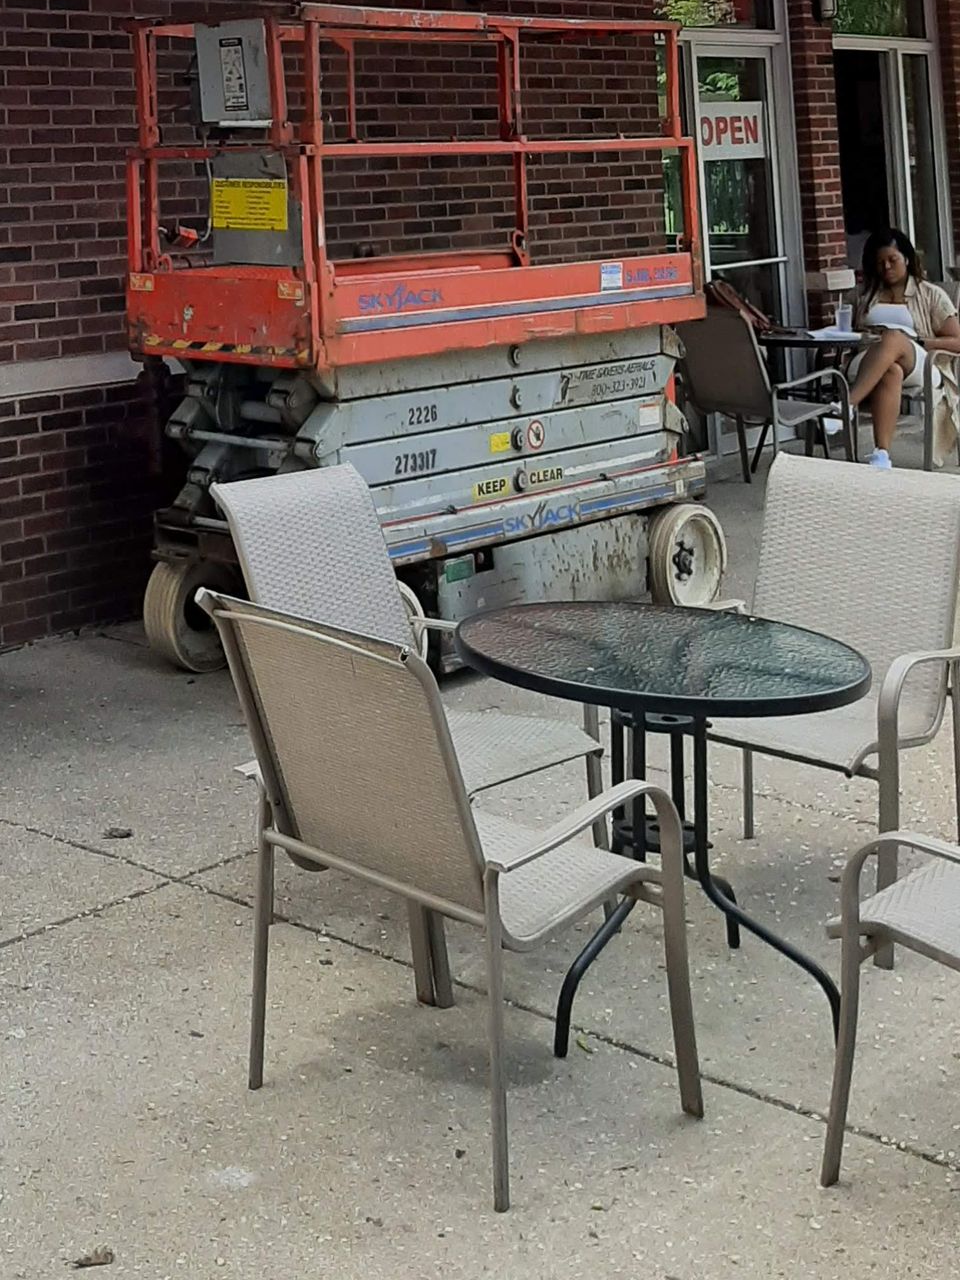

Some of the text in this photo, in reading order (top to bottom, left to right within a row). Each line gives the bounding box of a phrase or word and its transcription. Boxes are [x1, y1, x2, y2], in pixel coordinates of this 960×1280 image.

[700, 115, 759, 147] OPEN
[358, 282, 444, 312] SKYJACK
[408, 404, 438, 426] 2226
[394, 448, 438, 475] 273317
[477, 467, 563, 496] KEEP CLEAR
[503, 500, 580, 533] SKYJACK
